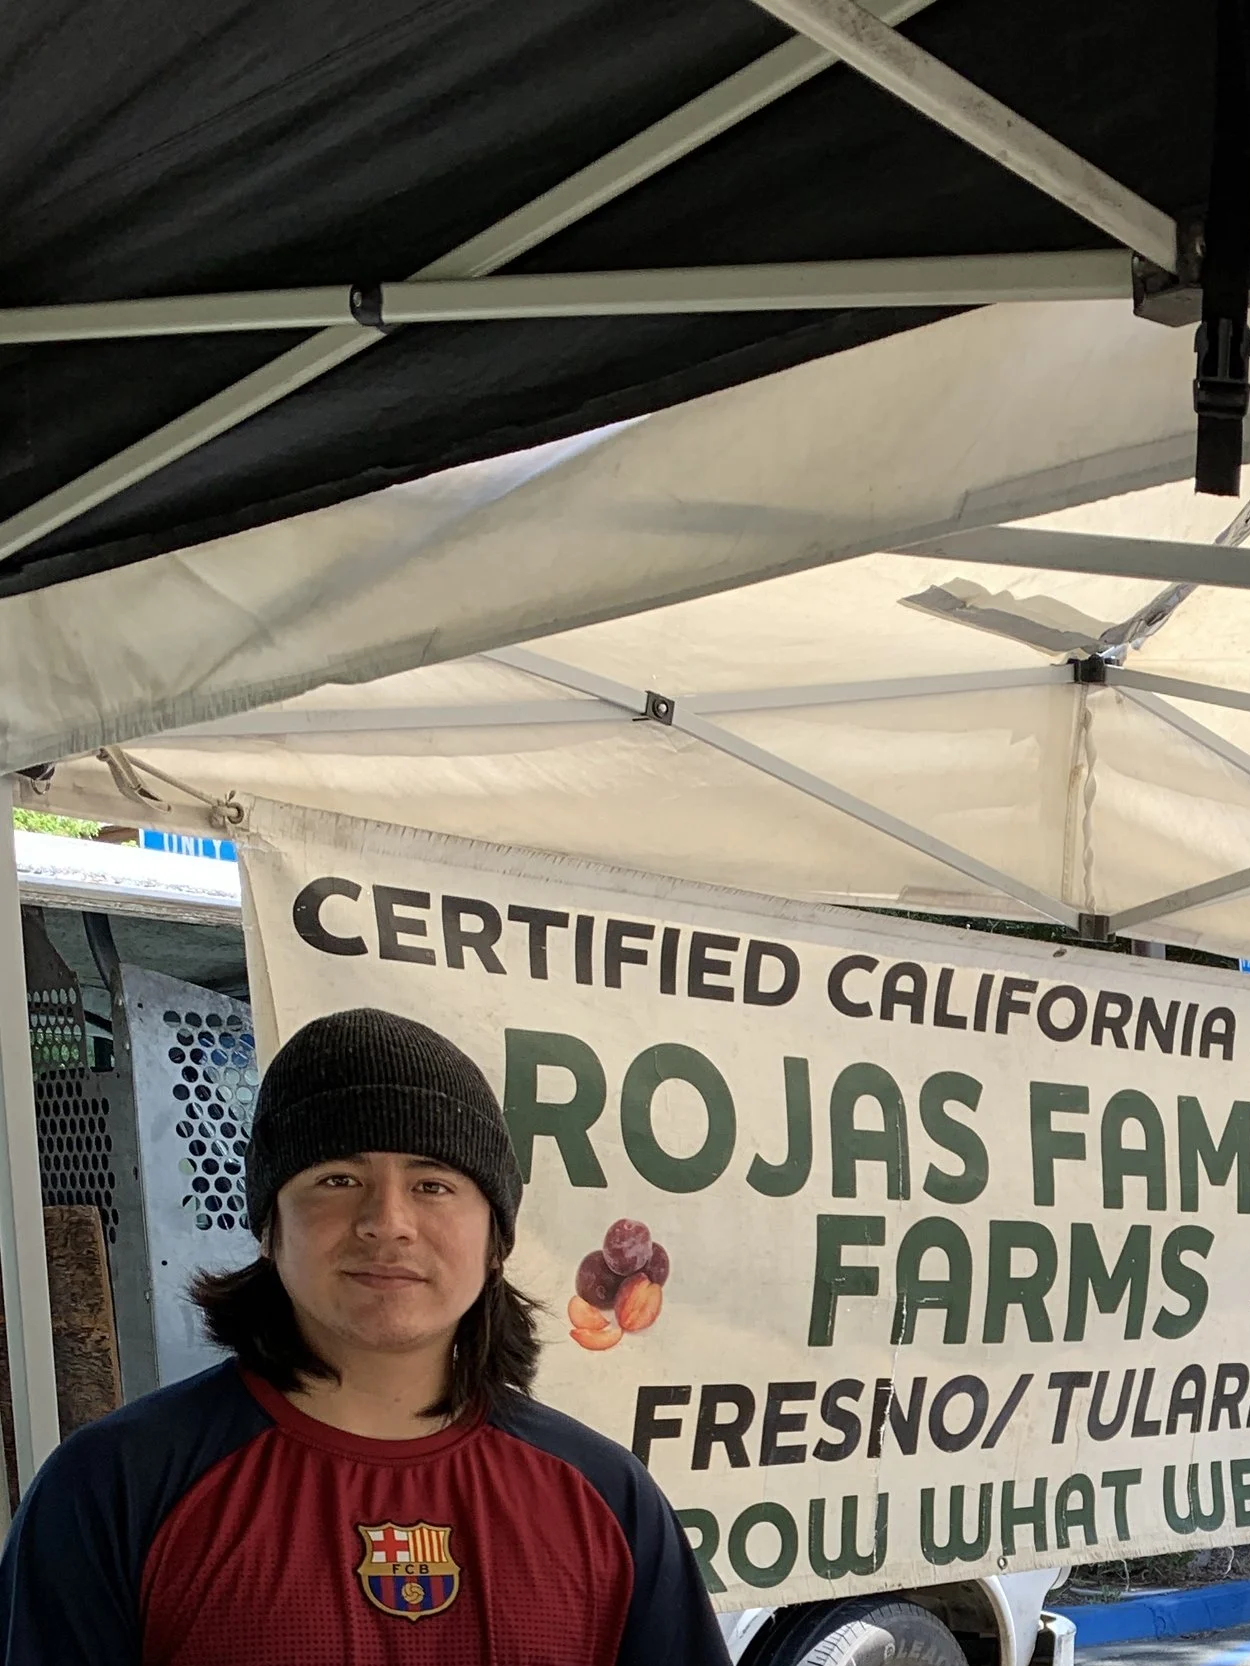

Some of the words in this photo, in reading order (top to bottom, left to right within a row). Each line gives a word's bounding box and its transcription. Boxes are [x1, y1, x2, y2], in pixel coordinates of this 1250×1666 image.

[292, 876, 801, 1007] CERTIFIED
[827, 954, 1237, 1061] CALIFORNIA
[503, 1027, 990, 1205] ROJAS
[807, 1213, 1215, 1347] FARMS
[680, 1491, 890, 1595] ROW
[919, 1467, 1143, 1567] WHAT
